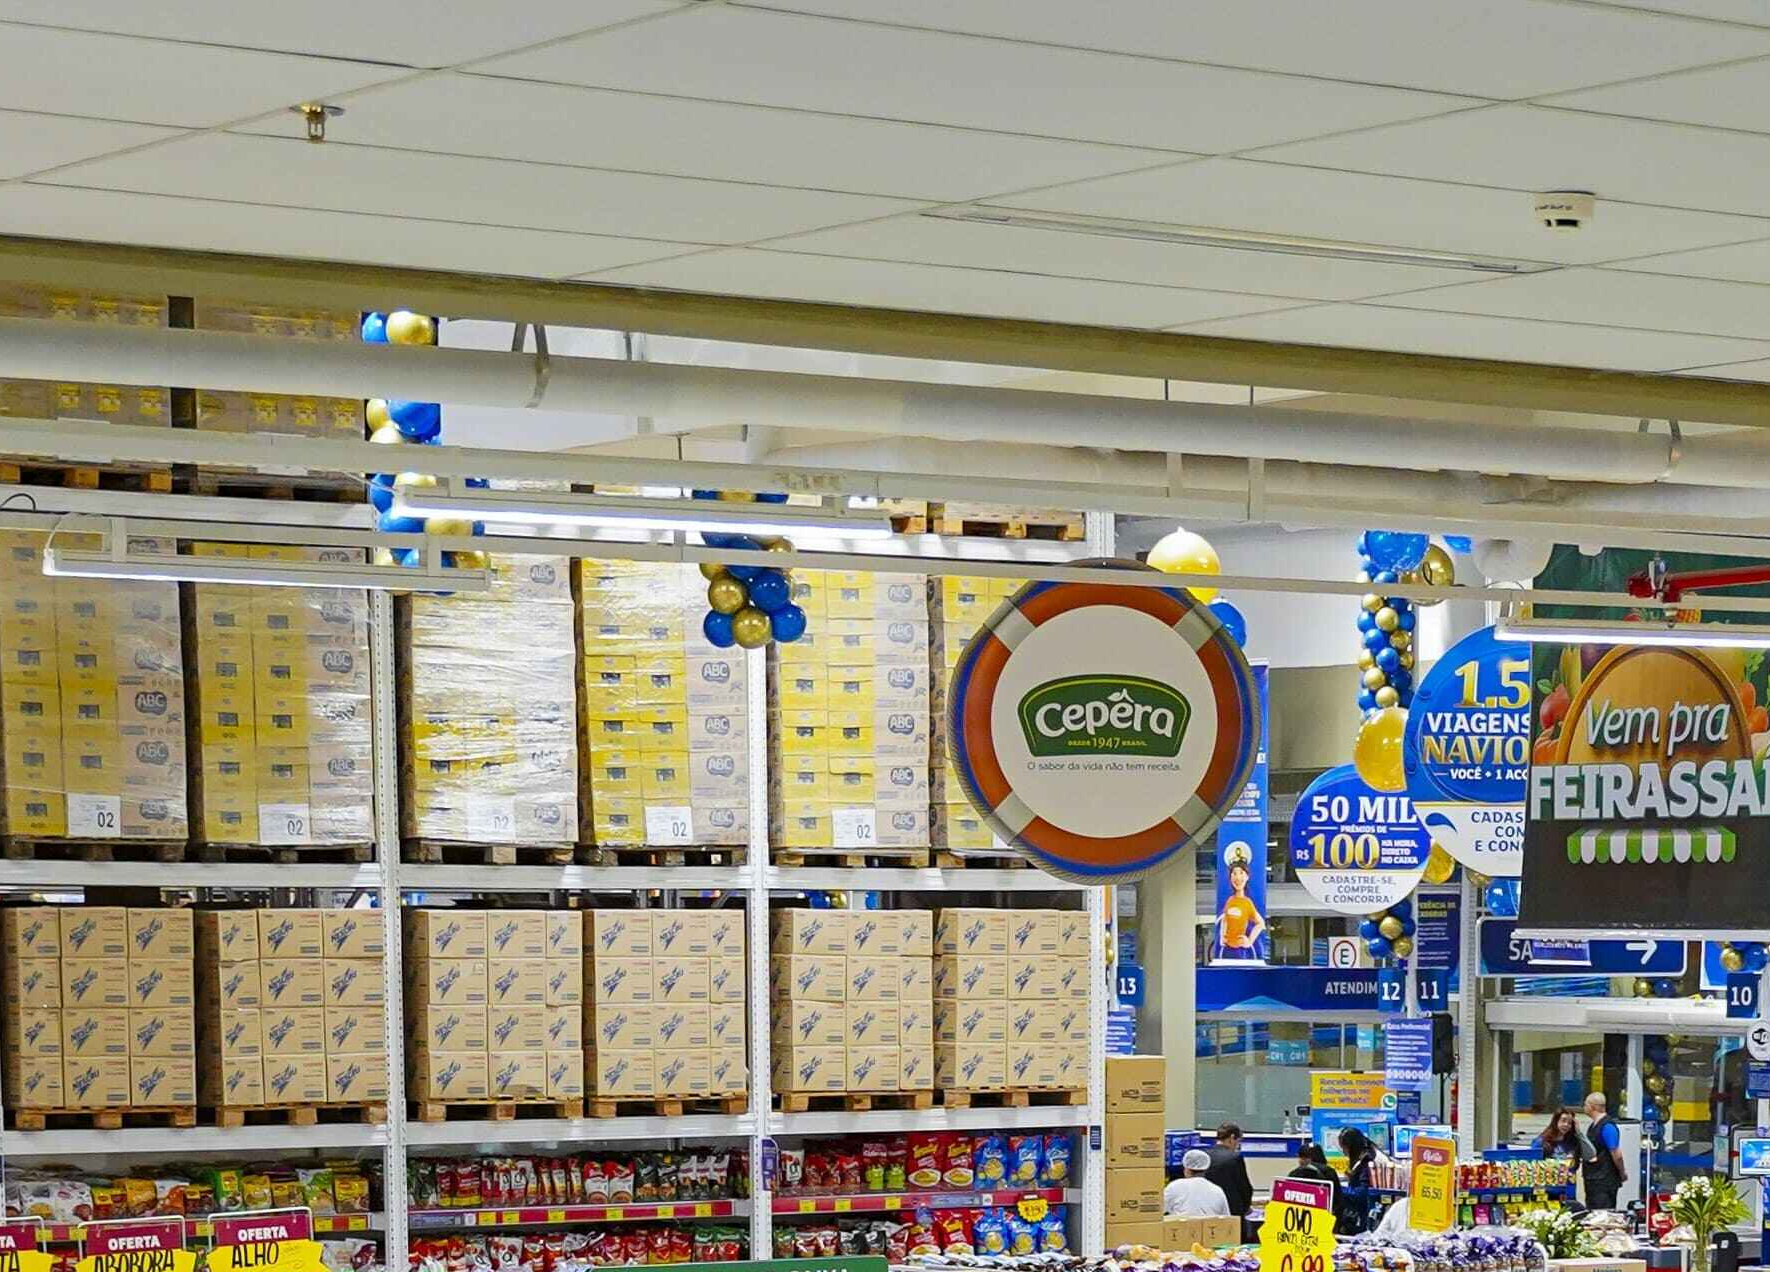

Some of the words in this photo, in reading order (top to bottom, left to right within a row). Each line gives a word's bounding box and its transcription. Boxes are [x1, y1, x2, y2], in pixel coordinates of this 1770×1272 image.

[1585, 701, 1659, 744] Vem
[1667, 701, 1730, 755] pra
[1092, 738, 1120, 748] 1947
[1039, 762, 1064, 770] sabor
[1106, 762, 1123, 770] não
[1312, 797, 1348, 822] 50
[1358, 797, 1417, 822] MIL
[1297, 850, 1309, 860] R$
[1309, 833, 1379, 868] 100
[1119, 978, 1135, 994] 13
[1382, 983, 1399, 1000] 12
[1421, 982, 1439, 998] 11
[1731, 986, 1751, 1006] 10
[1284, 1207, 1311, 1235] OVO
[238, 1227, 287, 1241] OFERTA
[108, 1236, 161, 1250] OFERTA
[232, 1242, 279, 1268] ALHO
